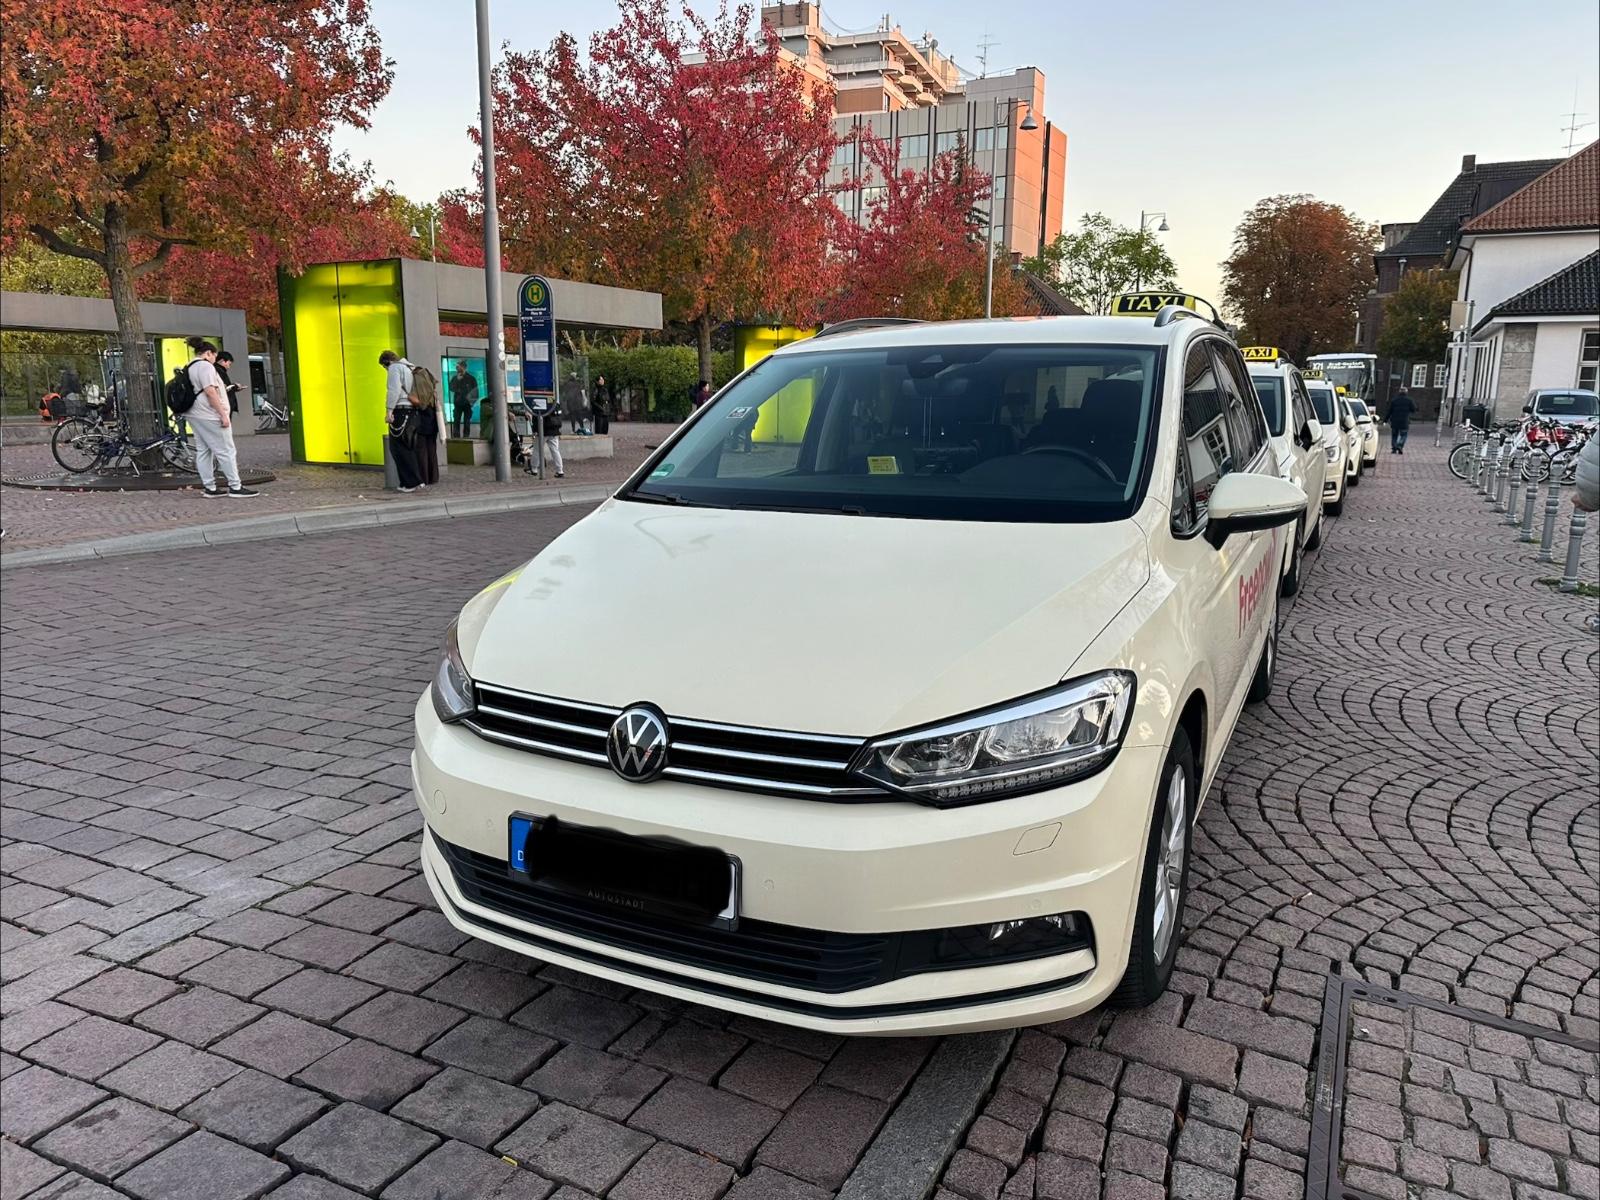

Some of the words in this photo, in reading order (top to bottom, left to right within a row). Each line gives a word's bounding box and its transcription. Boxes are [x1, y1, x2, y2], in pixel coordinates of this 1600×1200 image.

[530, 287, 541, 301] H
[1126, 296, 1180, 311] TAXI
[1242, 348, 1270, 357] TAXI
[517, 850, 525, 861] D
[587, 888, 645, 911] AUTOSTADT
